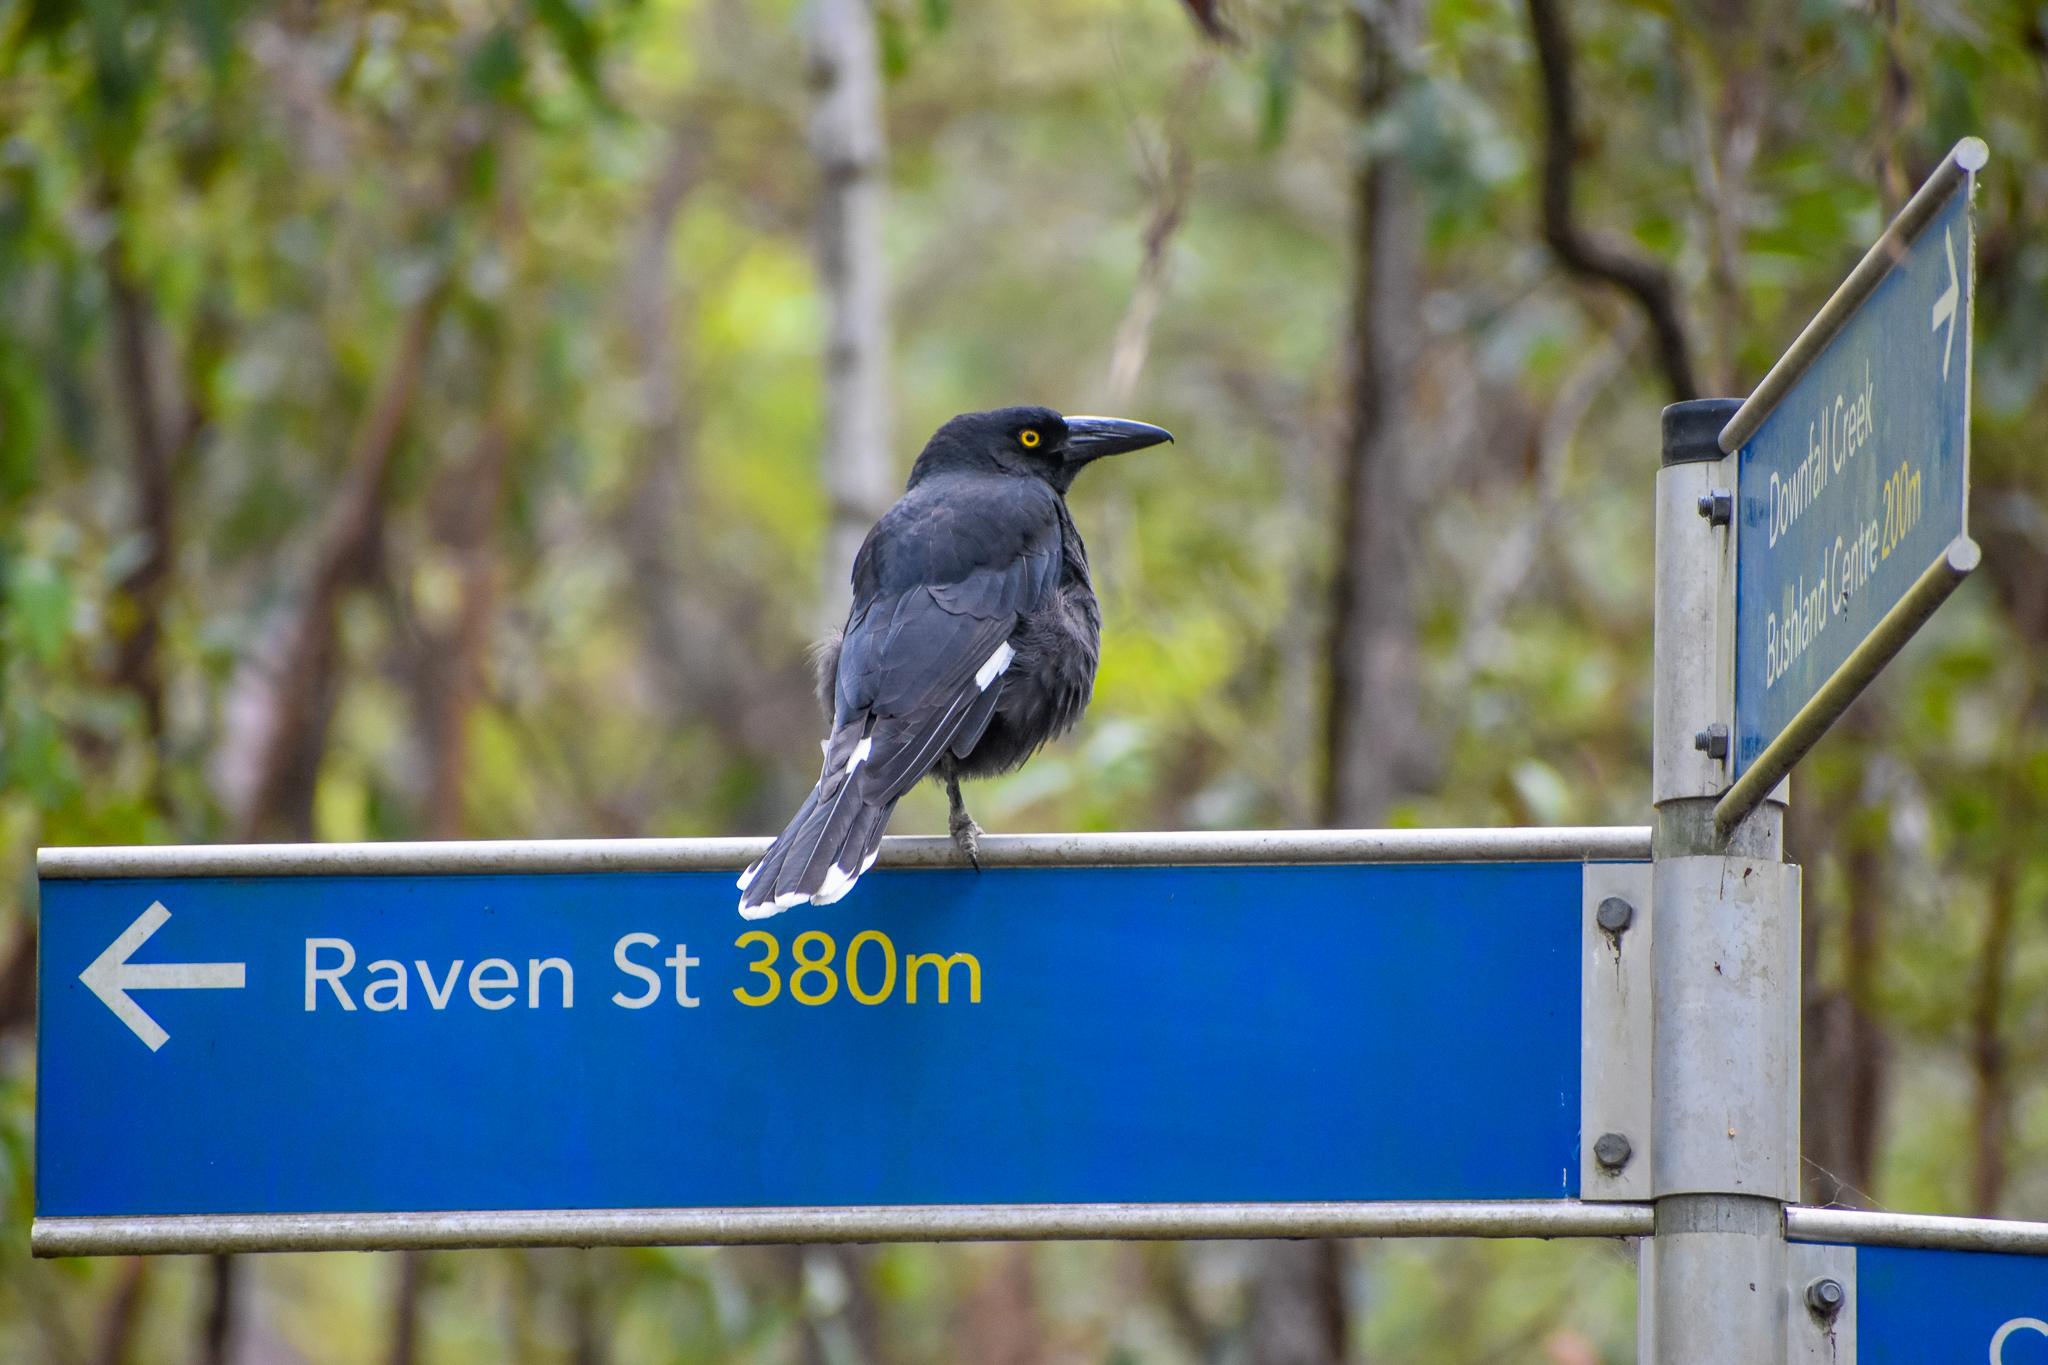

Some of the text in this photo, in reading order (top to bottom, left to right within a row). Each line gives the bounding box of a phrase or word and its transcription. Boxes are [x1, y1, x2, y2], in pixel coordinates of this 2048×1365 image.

[1769, 357, 1874, 549] Downfall Creek
[1767, 460, 1921, 690] Bushland Centre 200m
[304, 929, 982, 1012] Raven St 380m
